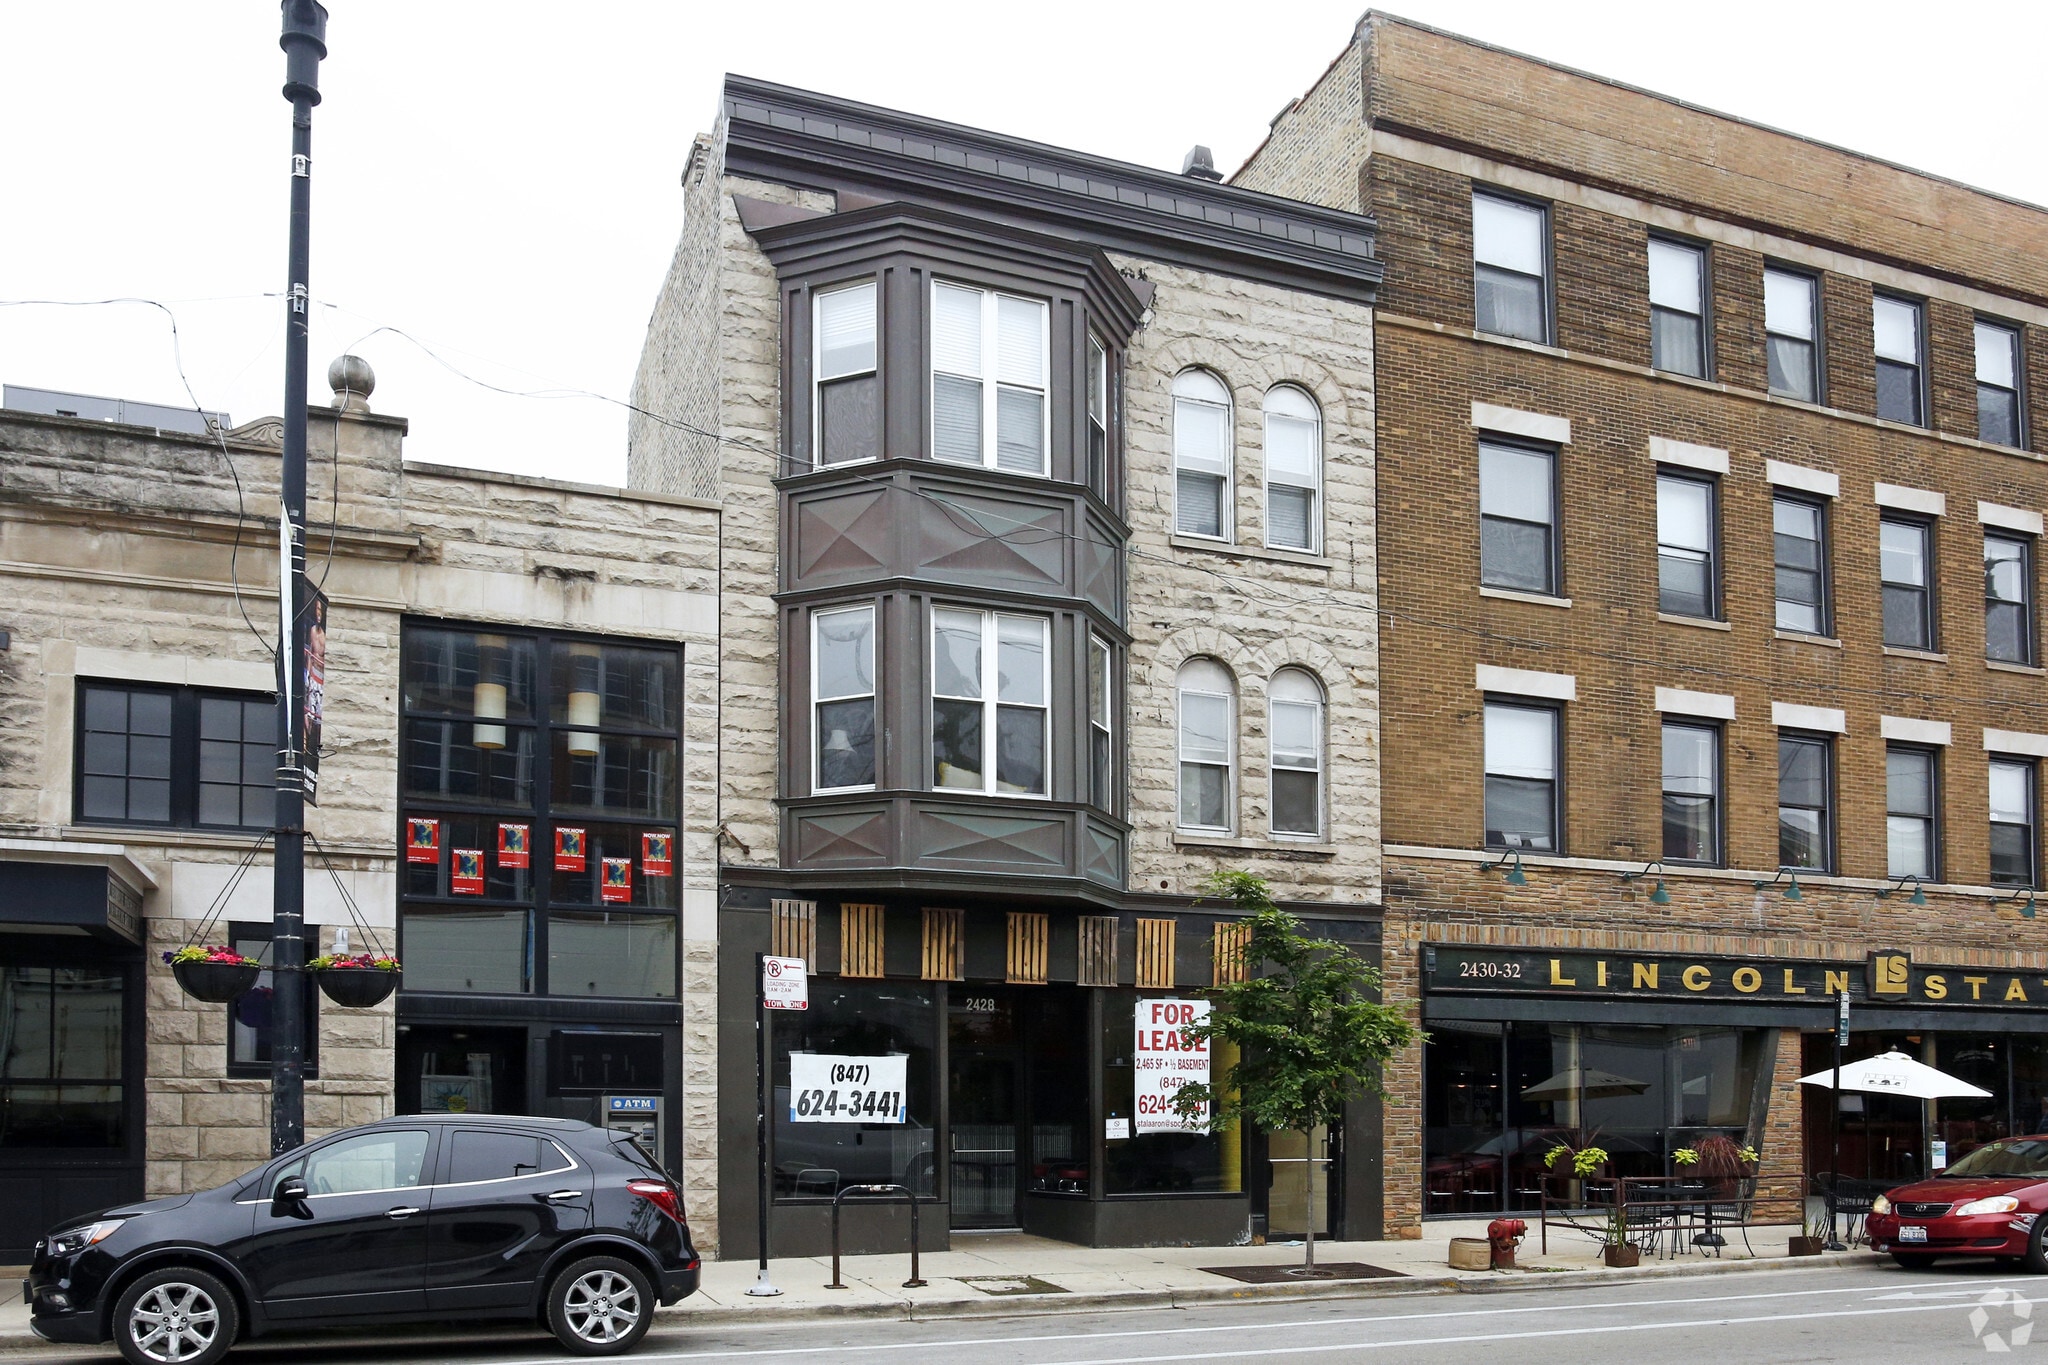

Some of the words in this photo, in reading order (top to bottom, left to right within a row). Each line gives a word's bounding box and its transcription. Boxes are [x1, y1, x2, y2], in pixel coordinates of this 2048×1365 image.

[1459, 962, 1521, 979] 2430-32
[1550, 959, 1849, 996] LINCOLN
[1924, 974, 2048, 1002] STA
[966, 998, 995, 1012] 2428
[1152, 1003, 1194, 1025] FOR
[1138, 1030, 1207, 1052] LEASE
[830, 1063, 870, 1086] (847)
[1136, 1058, 1154, 1071] 2,465
[1155, 1058, 1163, 1070] SF
[1177, 1058, 1209, 1071] BASEMENT
[624, 1099, 651, 1107] ATM
[797, 1089, 900, 1118] 624-3441
[1138, 1094, 1207, 1115] 624-41
